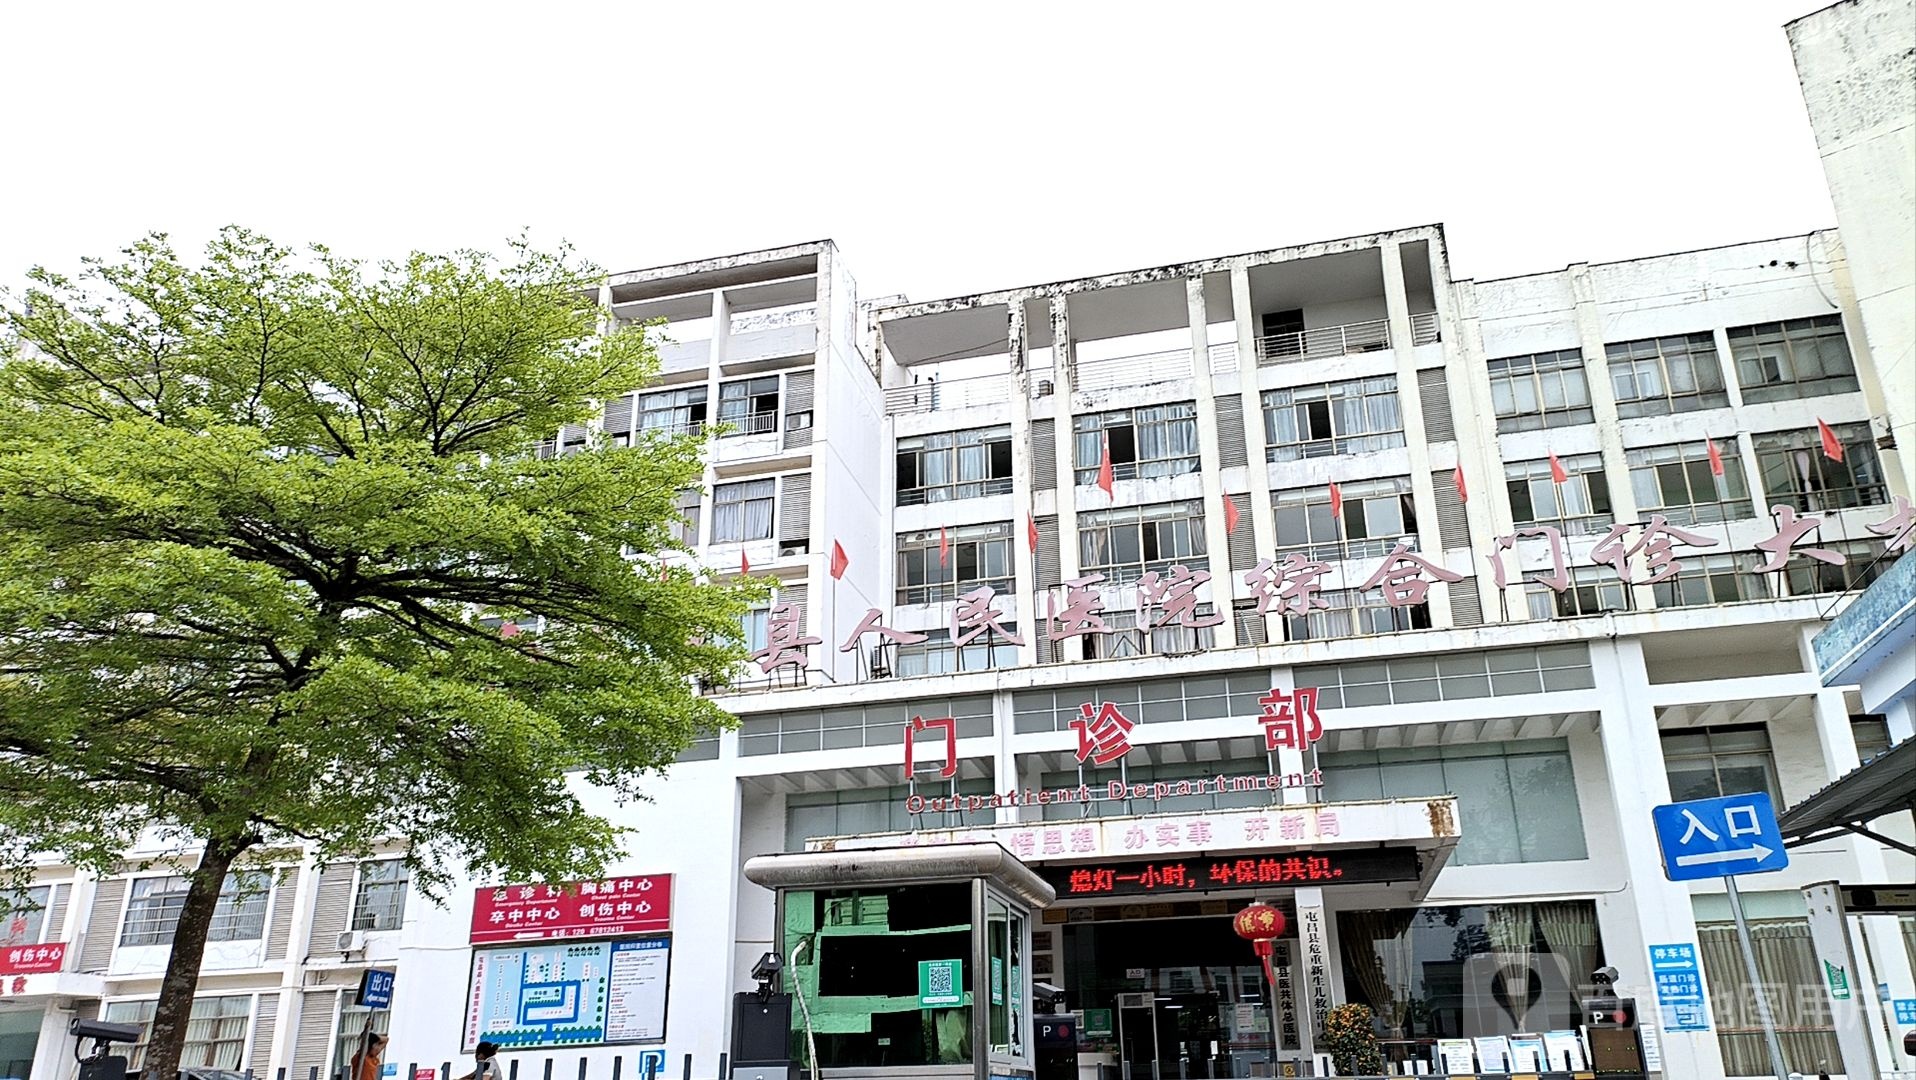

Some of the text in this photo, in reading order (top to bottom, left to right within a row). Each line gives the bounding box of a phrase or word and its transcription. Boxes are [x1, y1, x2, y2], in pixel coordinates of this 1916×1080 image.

[904, 686, 1324, 780] 门诊部
[906, 767, 1323, 814] Outpatient Department
[1680, 805, 1762, 845] 入口
[1010, 813, 1340, 856] 悟思想 办实事 开新局
[581, 878, 653, 895] 胸痛中心
[489, 907, 560, 924] 卒中中心
[579, 900, 651, 917] 创伤中心
[9, 947, 62, 963] 创伤中心
[1654, 947, 1692, 959] 停车场
[371, 974, 392, 992] 出口
[1275, 945, 1298, 1046] 屯昌县医共体总医院
[1593, 1011, 1604, 1024] P
[1043, 1025, 1052, 1037] P
